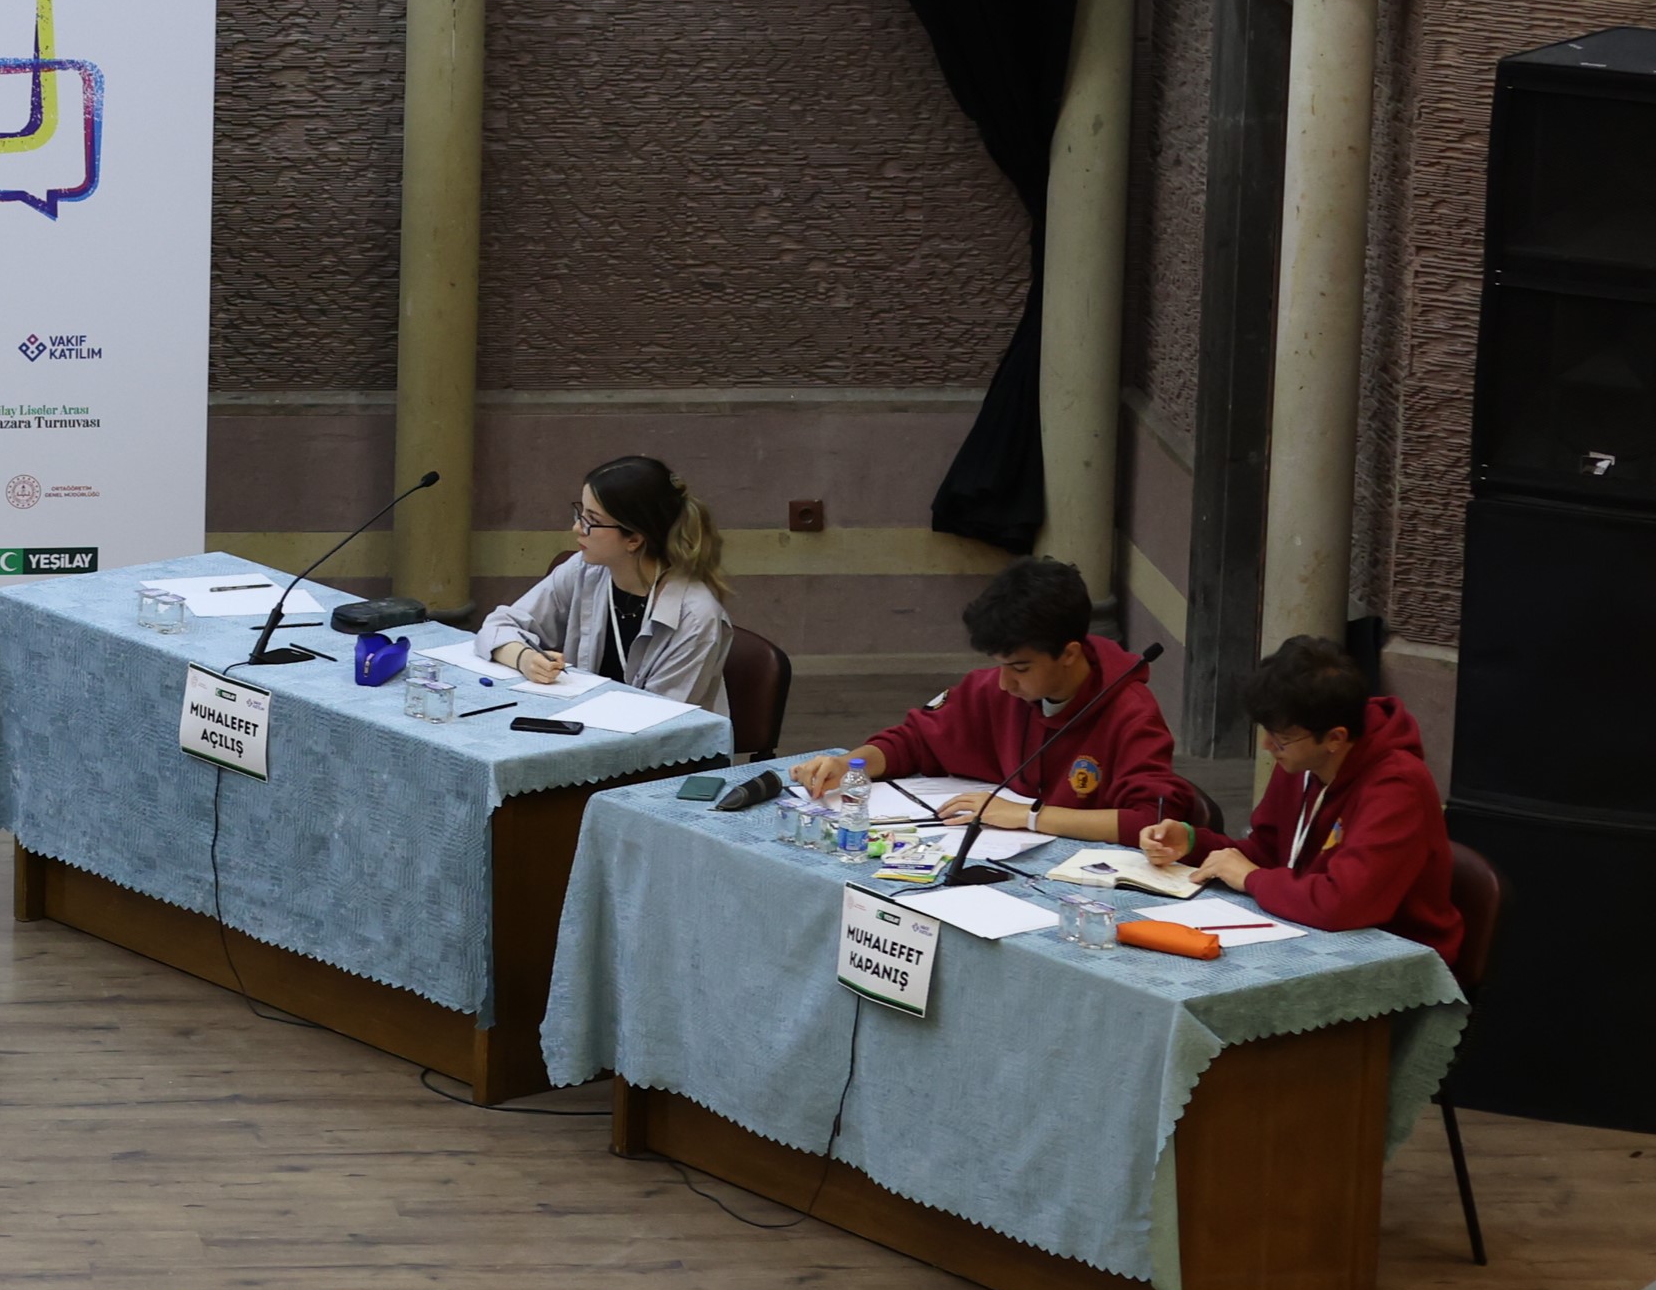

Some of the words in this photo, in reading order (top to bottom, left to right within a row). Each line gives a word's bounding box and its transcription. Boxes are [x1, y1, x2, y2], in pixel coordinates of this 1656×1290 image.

[49, 335, 86, 347] VAKIF
[49, 348, 102, 359] KATILIM
[34, 416, 101, 428] Turnuvası
[189, 701, 259, 737] MUHALEFET
[201, 728, 244, 758] AÇILIŞ
[847, 924, 924, 965] MUHALEFET
[849, 950, 909, 992] KAPANIŞ
